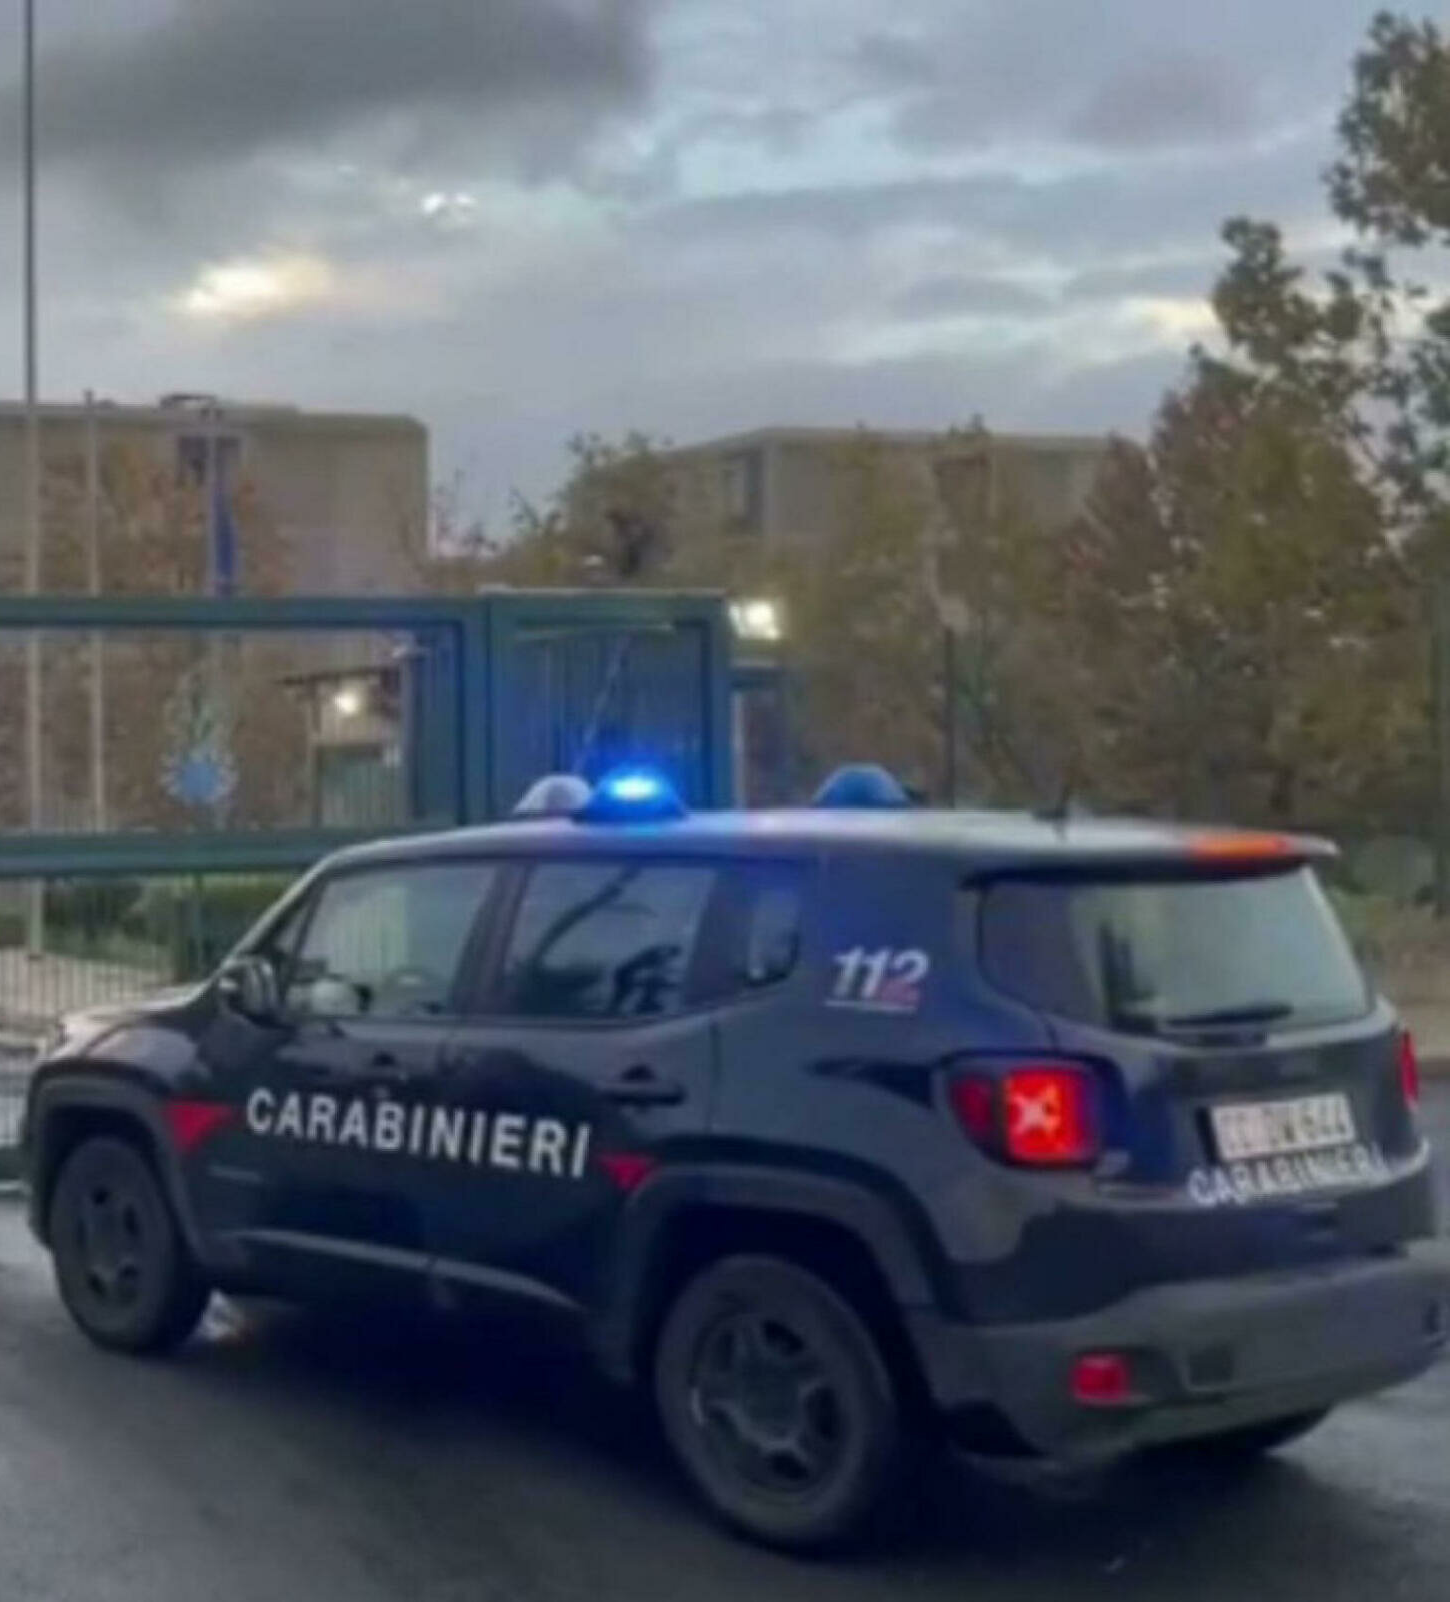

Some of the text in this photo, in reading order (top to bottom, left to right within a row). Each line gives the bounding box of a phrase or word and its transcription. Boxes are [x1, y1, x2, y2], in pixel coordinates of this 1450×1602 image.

[832, 946, 930, 1000] 112
[246, 1087, 593, 1179] CARABINIERI
[1189, 1142, 1388, 1205] CARABINIERI
